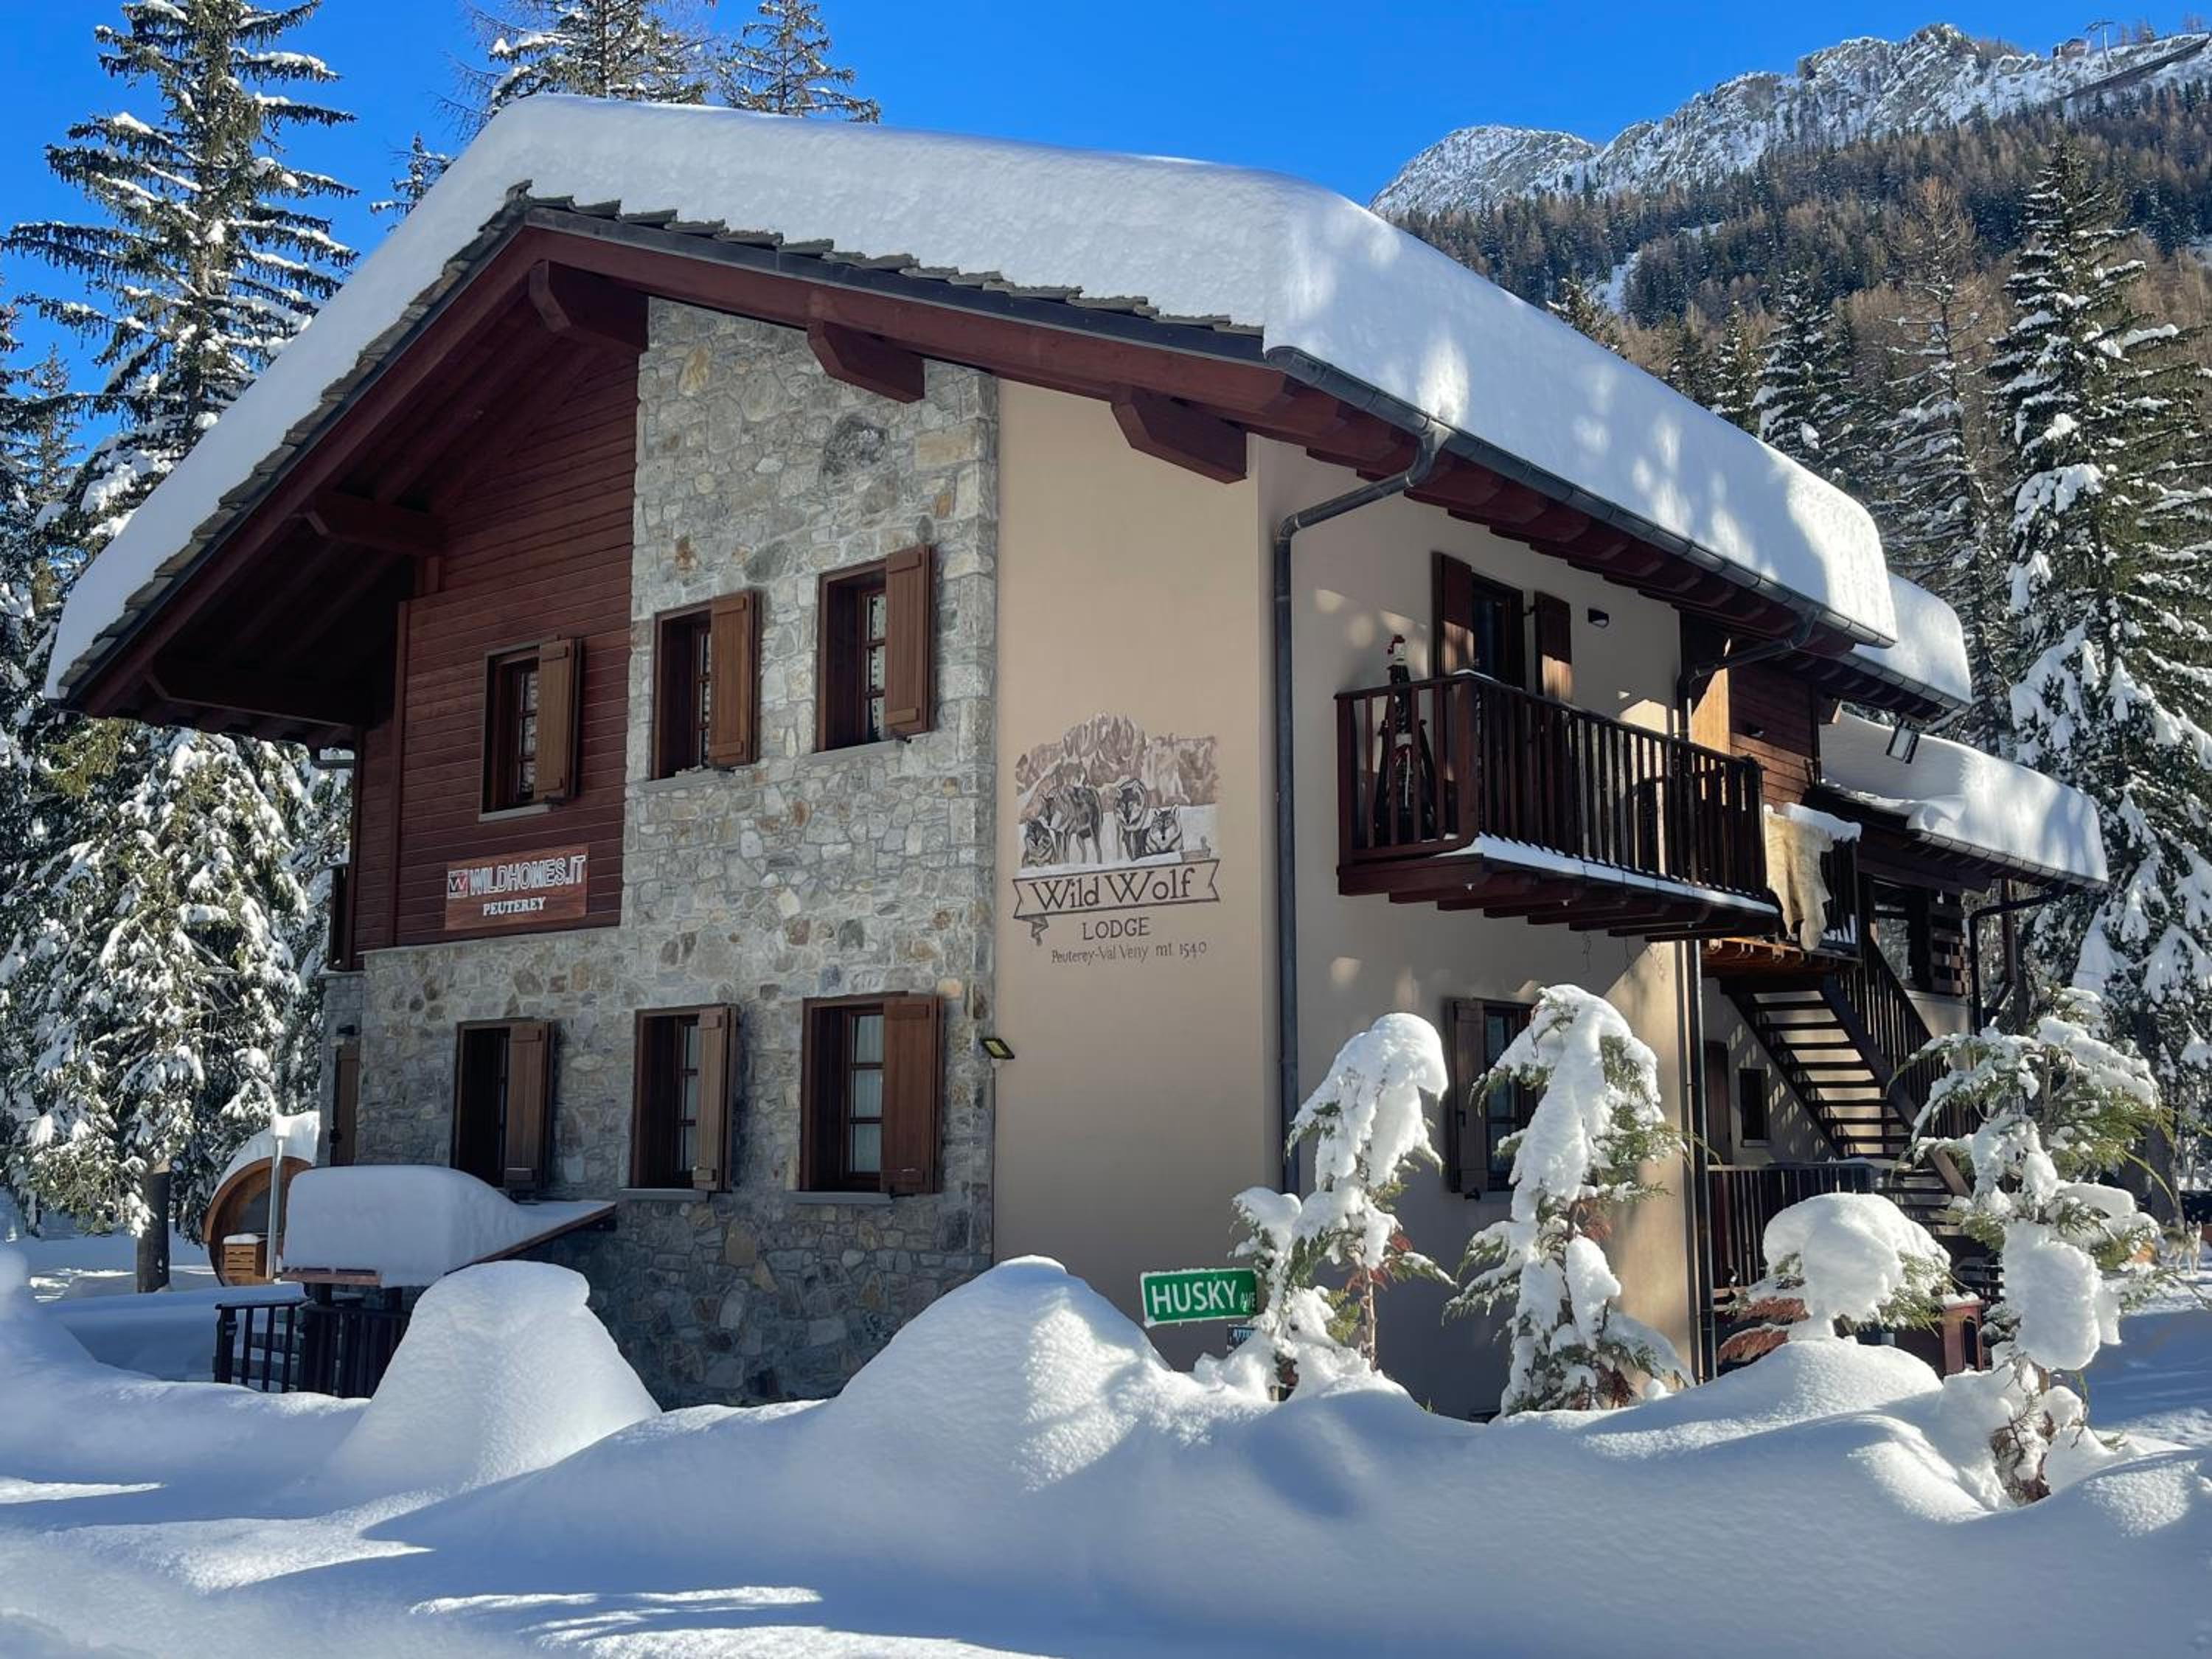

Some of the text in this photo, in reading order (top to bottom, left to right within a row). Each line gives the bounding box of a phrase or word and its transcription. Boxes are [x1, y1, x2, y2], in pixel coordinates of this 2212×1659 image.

[469, 855, 585, 895] WILDHOMES.IT
[1029, 867, 1195, 911] Wild Wolf
[483, 897, 546, 916] PEUTEREY
[1082, 917, 1151, 940] LODGE
[1151, 1280, 1237, 1315] HUSKY
